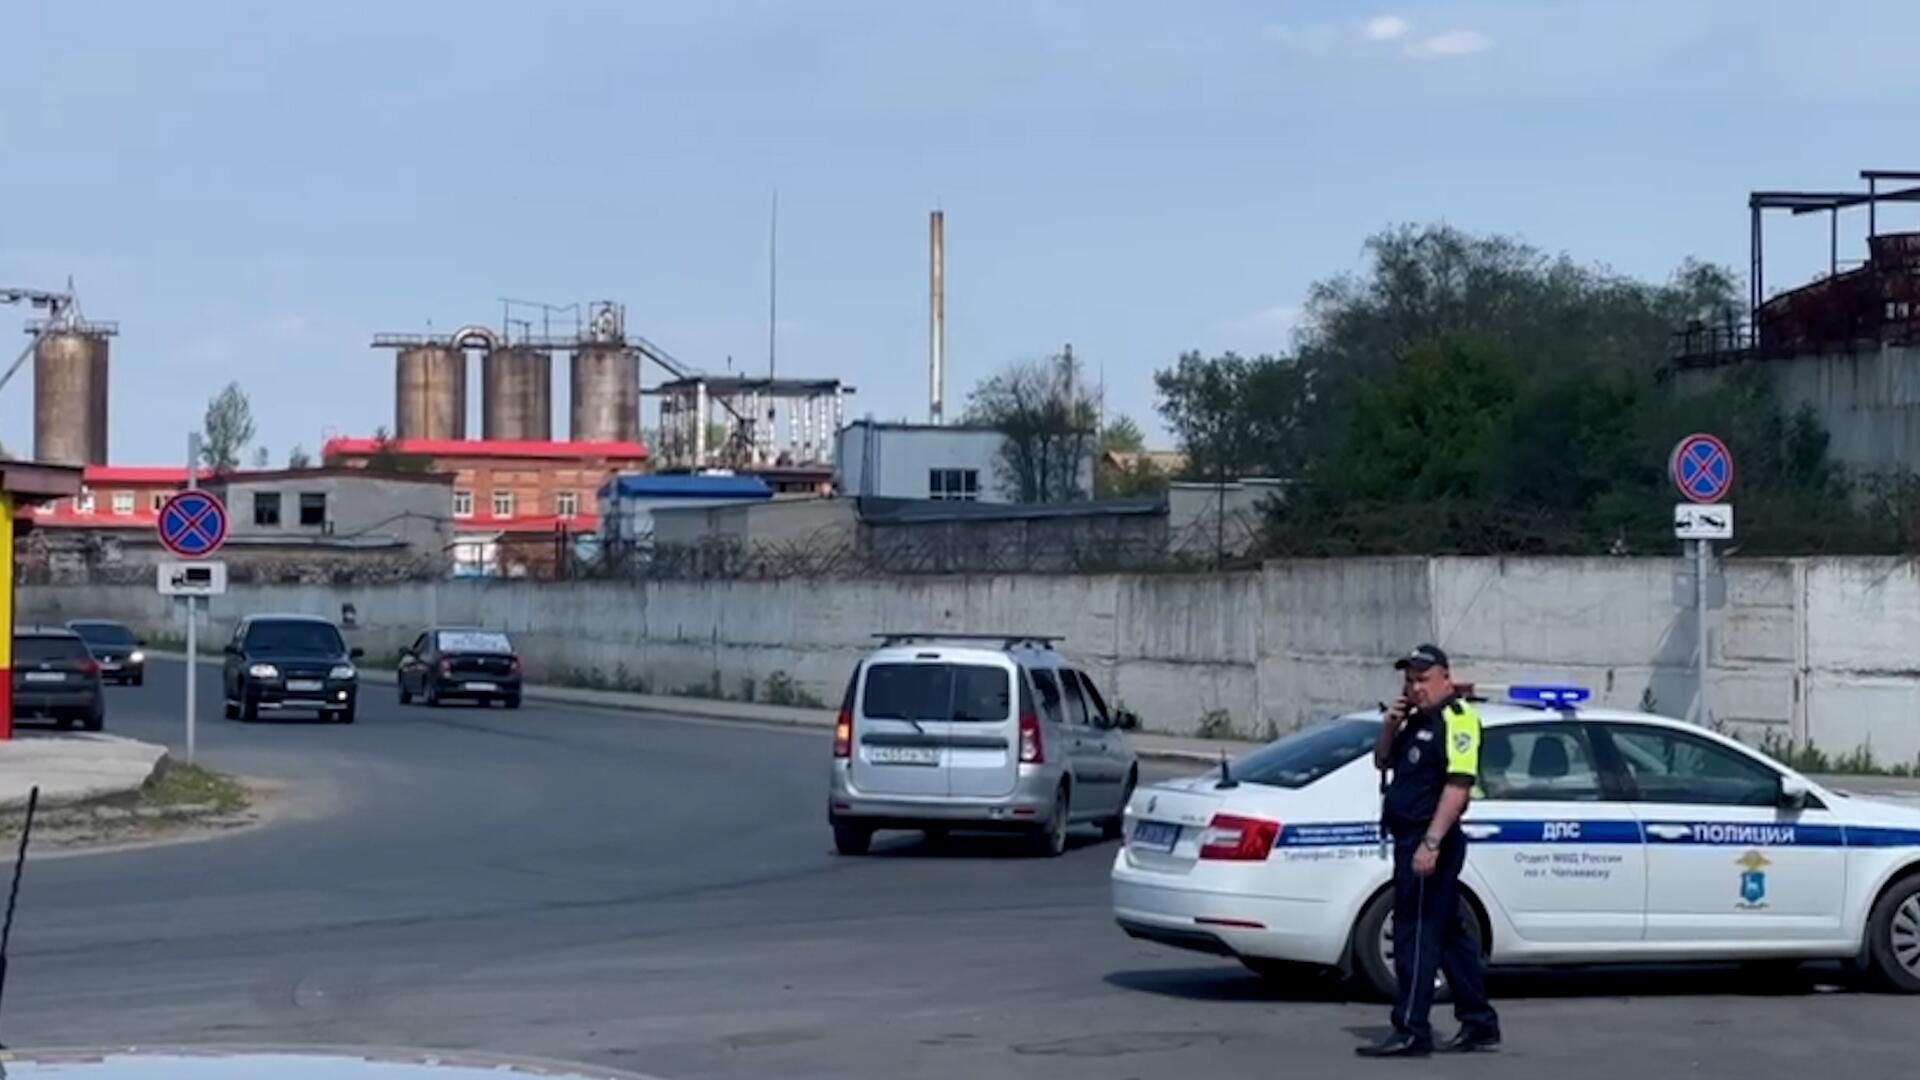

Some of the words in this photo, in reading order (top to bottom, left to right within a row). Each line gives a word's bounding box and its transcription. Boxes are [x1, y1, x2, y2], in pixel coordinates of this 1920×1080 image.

[1541, 822, 1581, 841] ДПС
[1693, 824, 1796, 846] ПОЛИЦИЯ
[1514, 852, 1550, 864] Отдел
[1581, 852, 1623, 864] России
